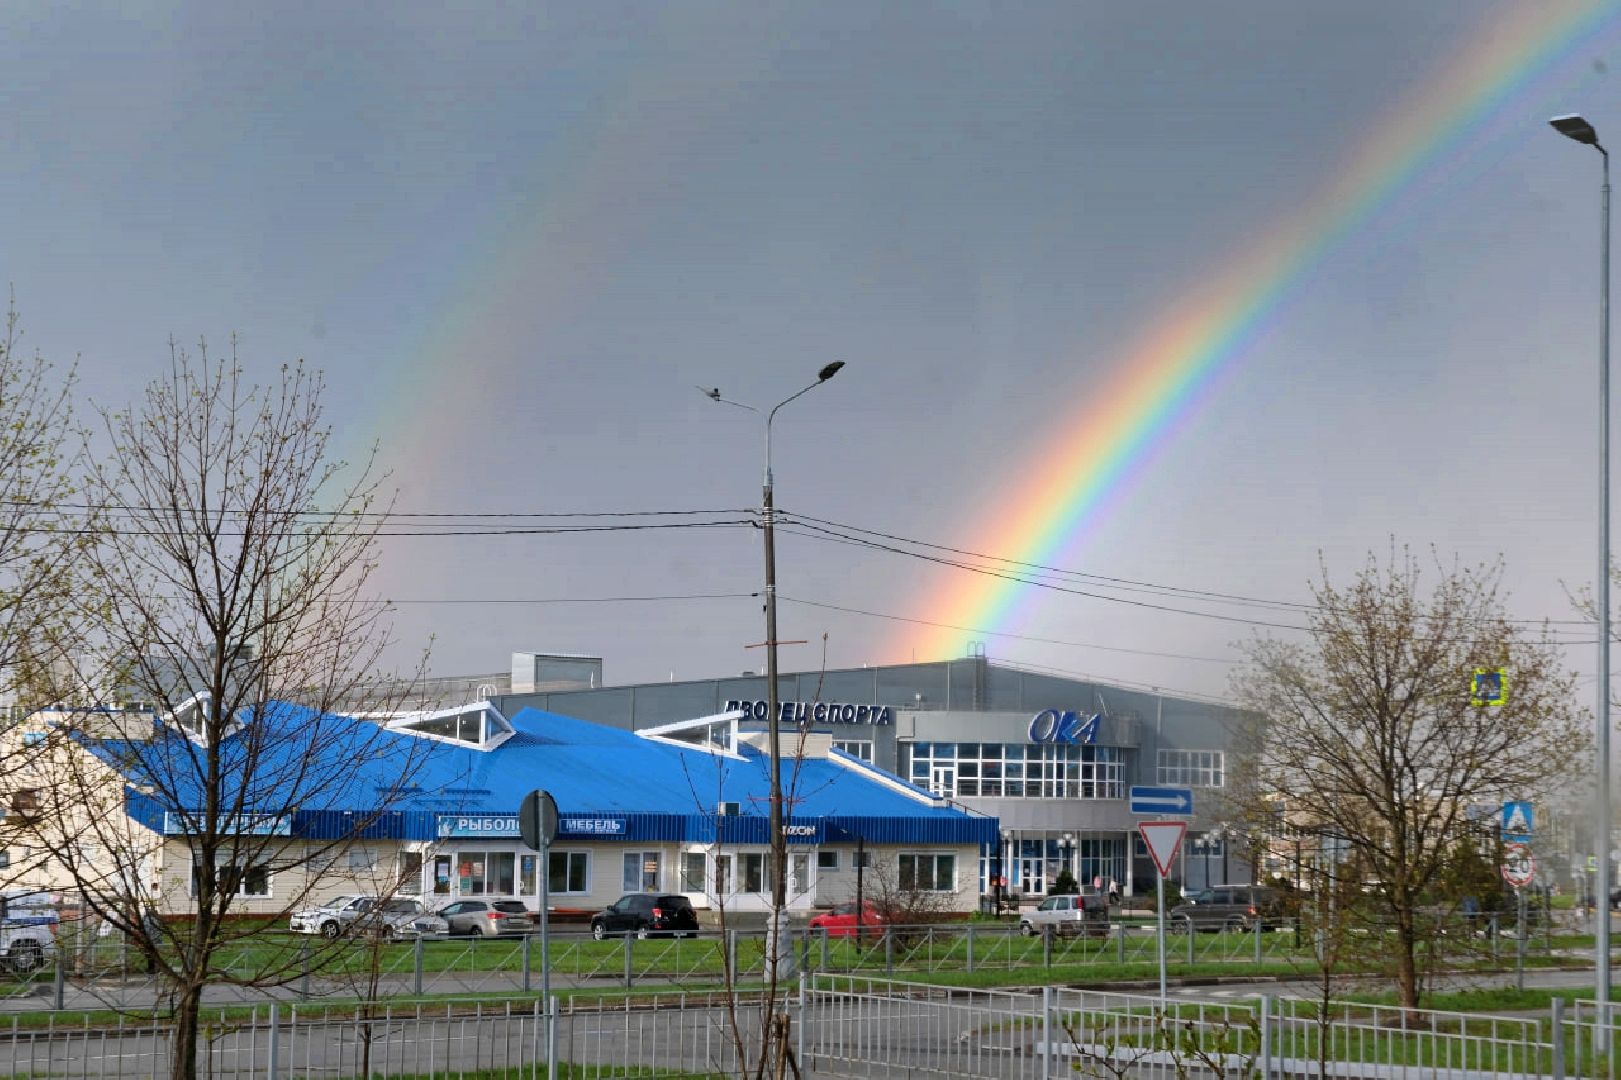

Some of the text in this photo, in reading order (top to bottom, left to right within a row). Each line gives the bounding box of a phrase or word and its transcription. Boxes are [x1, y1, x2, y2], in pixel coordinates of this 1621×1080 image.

[813, 702, 889, 725] СПОРТА
[1028, 709, 1101, 745] ОКА
[566, 819, 621, 831] МЕБЕЛЬ
